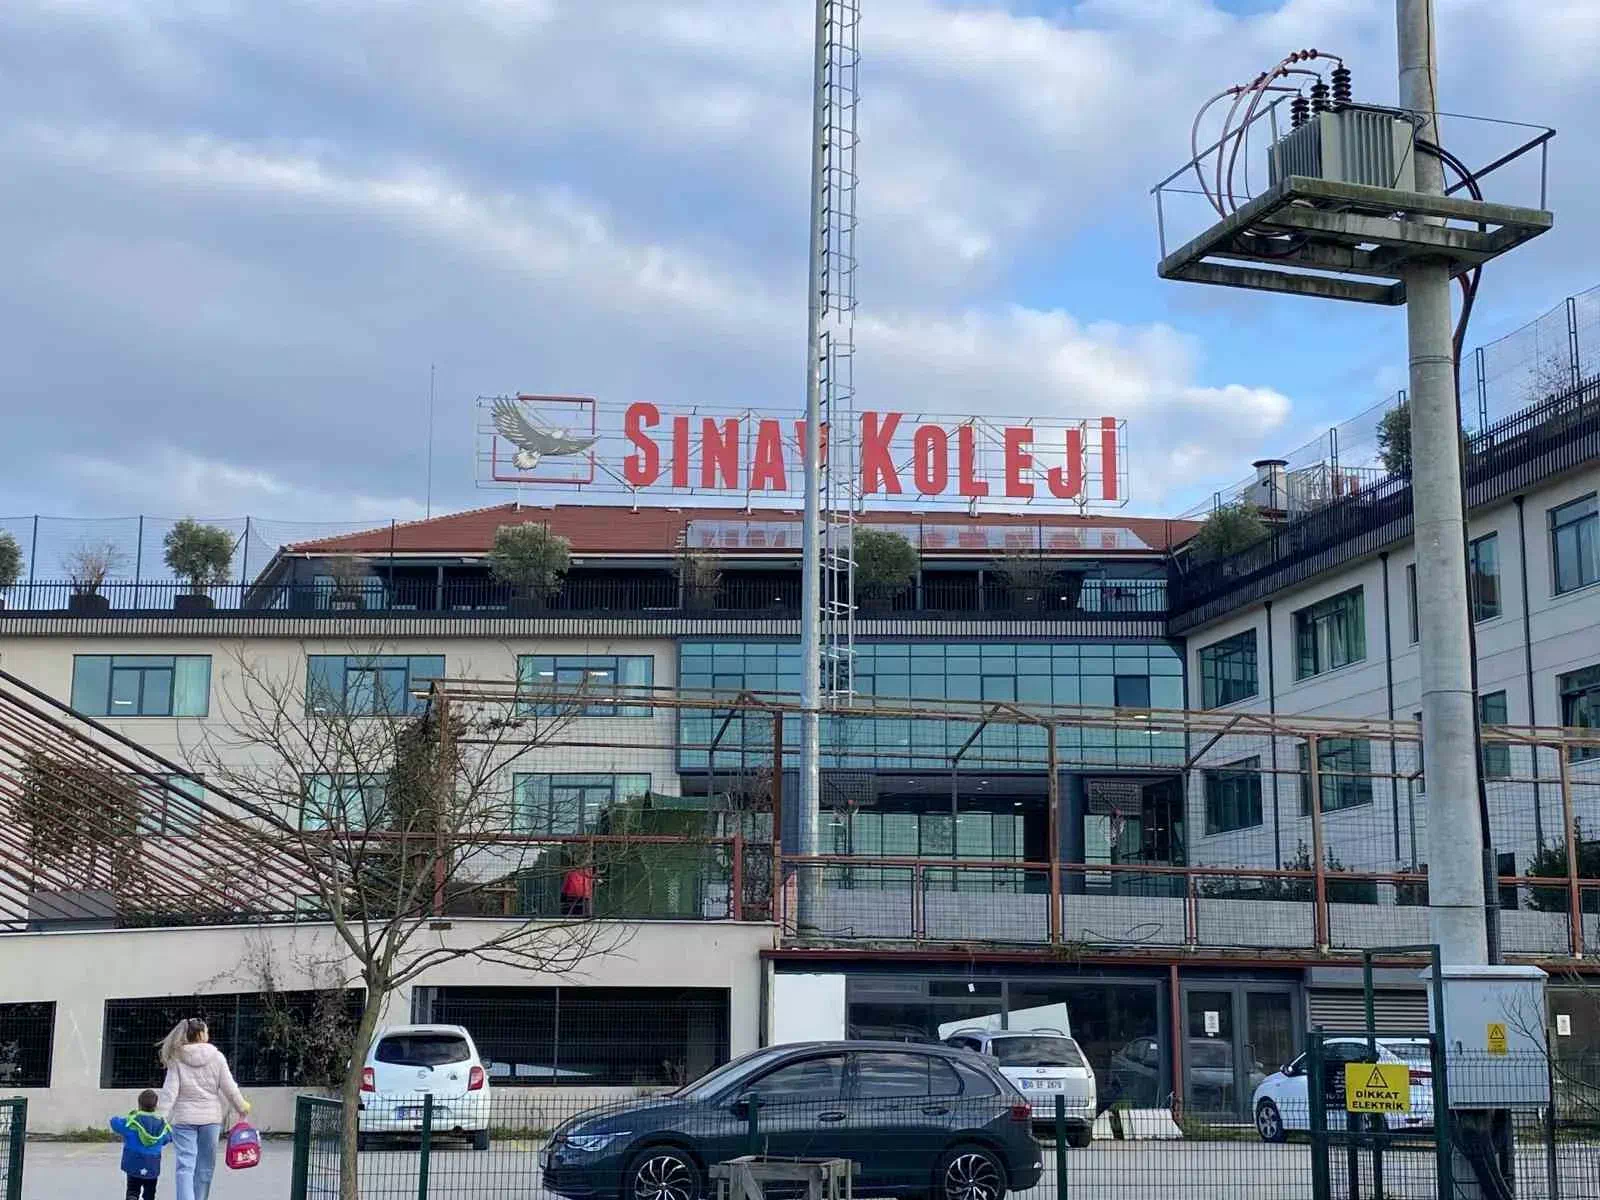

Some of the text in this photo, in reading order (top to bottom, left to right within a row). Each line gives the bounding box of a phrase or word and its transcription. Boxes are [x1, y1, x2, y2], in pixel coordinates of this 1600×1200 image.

[862, 411, 1117, 500] KOLEJİ
[1355, 1089, 1401, 1099] DİKKAT
[1352, 1101, 1404, 1110] ELEKTRİK
